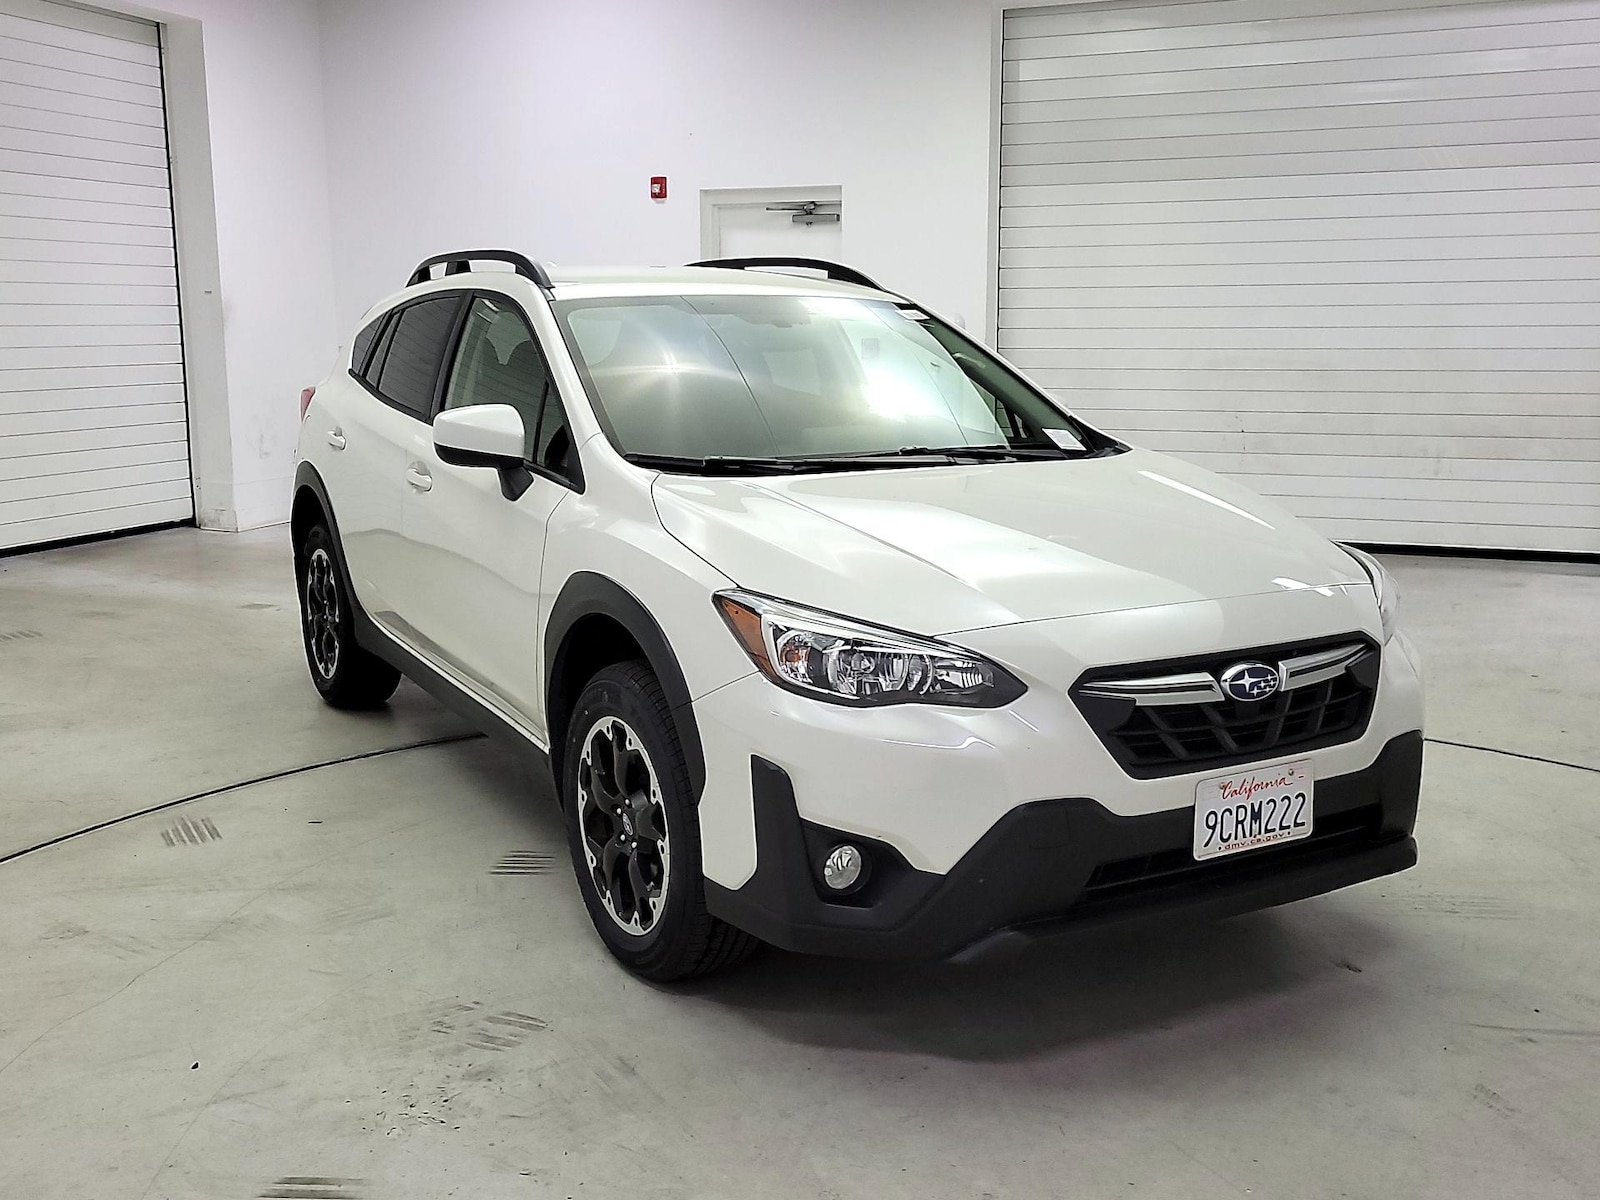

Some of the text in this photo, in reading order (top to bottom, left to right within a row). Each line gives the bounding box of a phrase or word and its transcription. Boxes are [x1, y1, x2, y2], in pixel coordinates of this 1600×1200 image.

[1222, 776, 1293, 801] California
[1203, 792, 1307, 848] 9CRM222
[1224, 832, 1285, 851] dmv.ca.gov
